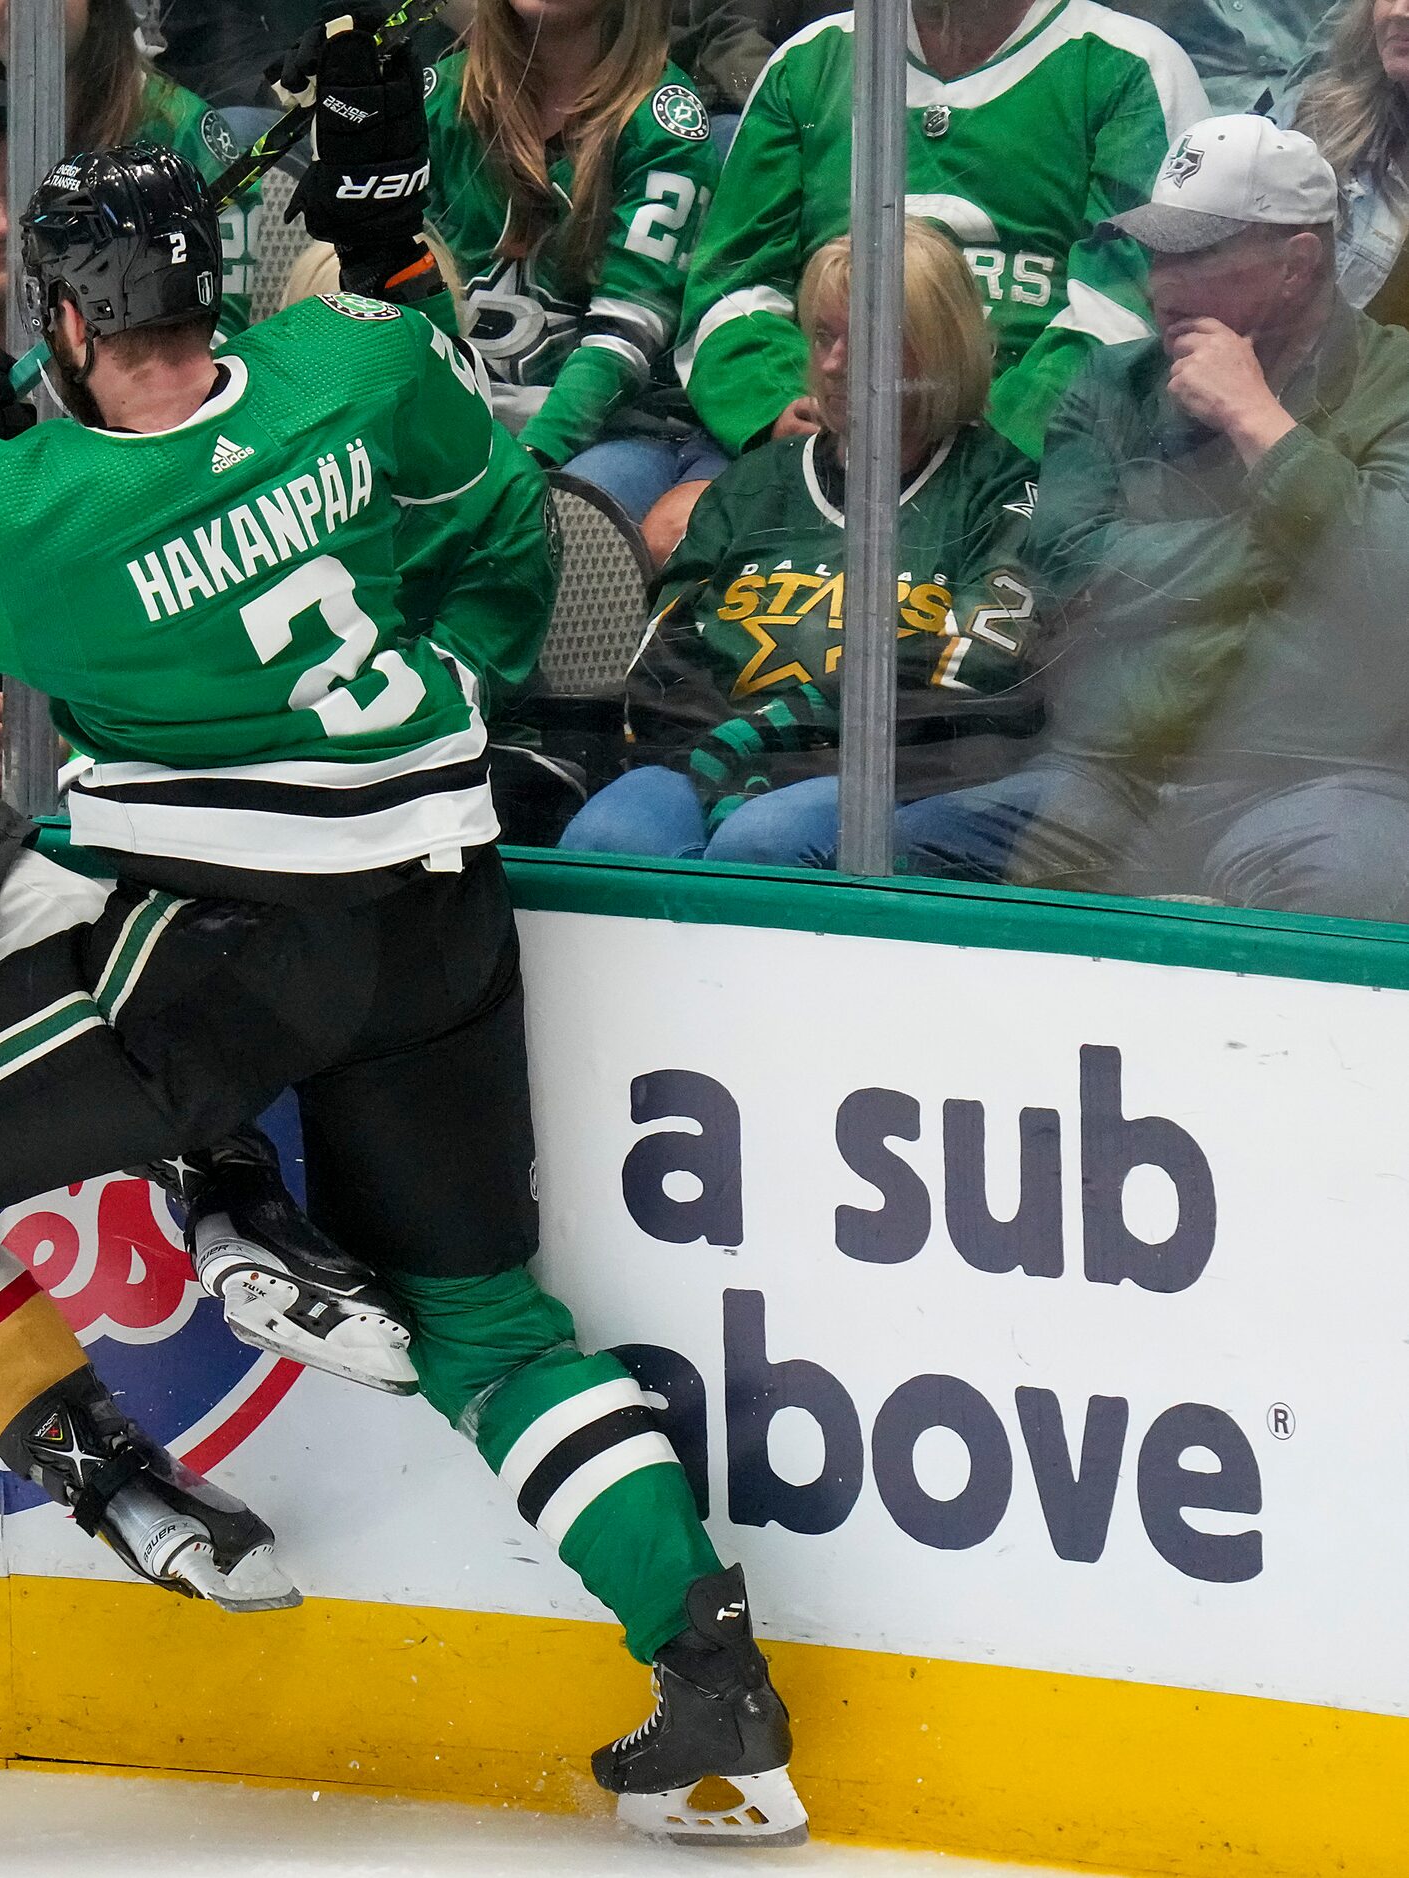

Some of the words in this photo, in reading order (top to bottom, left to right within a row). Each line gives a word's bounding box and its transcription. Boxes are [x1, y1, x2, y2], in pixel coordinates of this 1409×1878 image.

[169, 233, 187, 264] 2
[212, 446, 255, 474] adidas
[126, 437, 373, 623] HAKANPÄÄ
[717, 571, 954, 633] STAS
[741, 559, 948, 587] DALAS
[239, 553, 427, 738] 2
[621, 1069, 745, 1247] a
[834, 1044, 1218, 1294] sub
